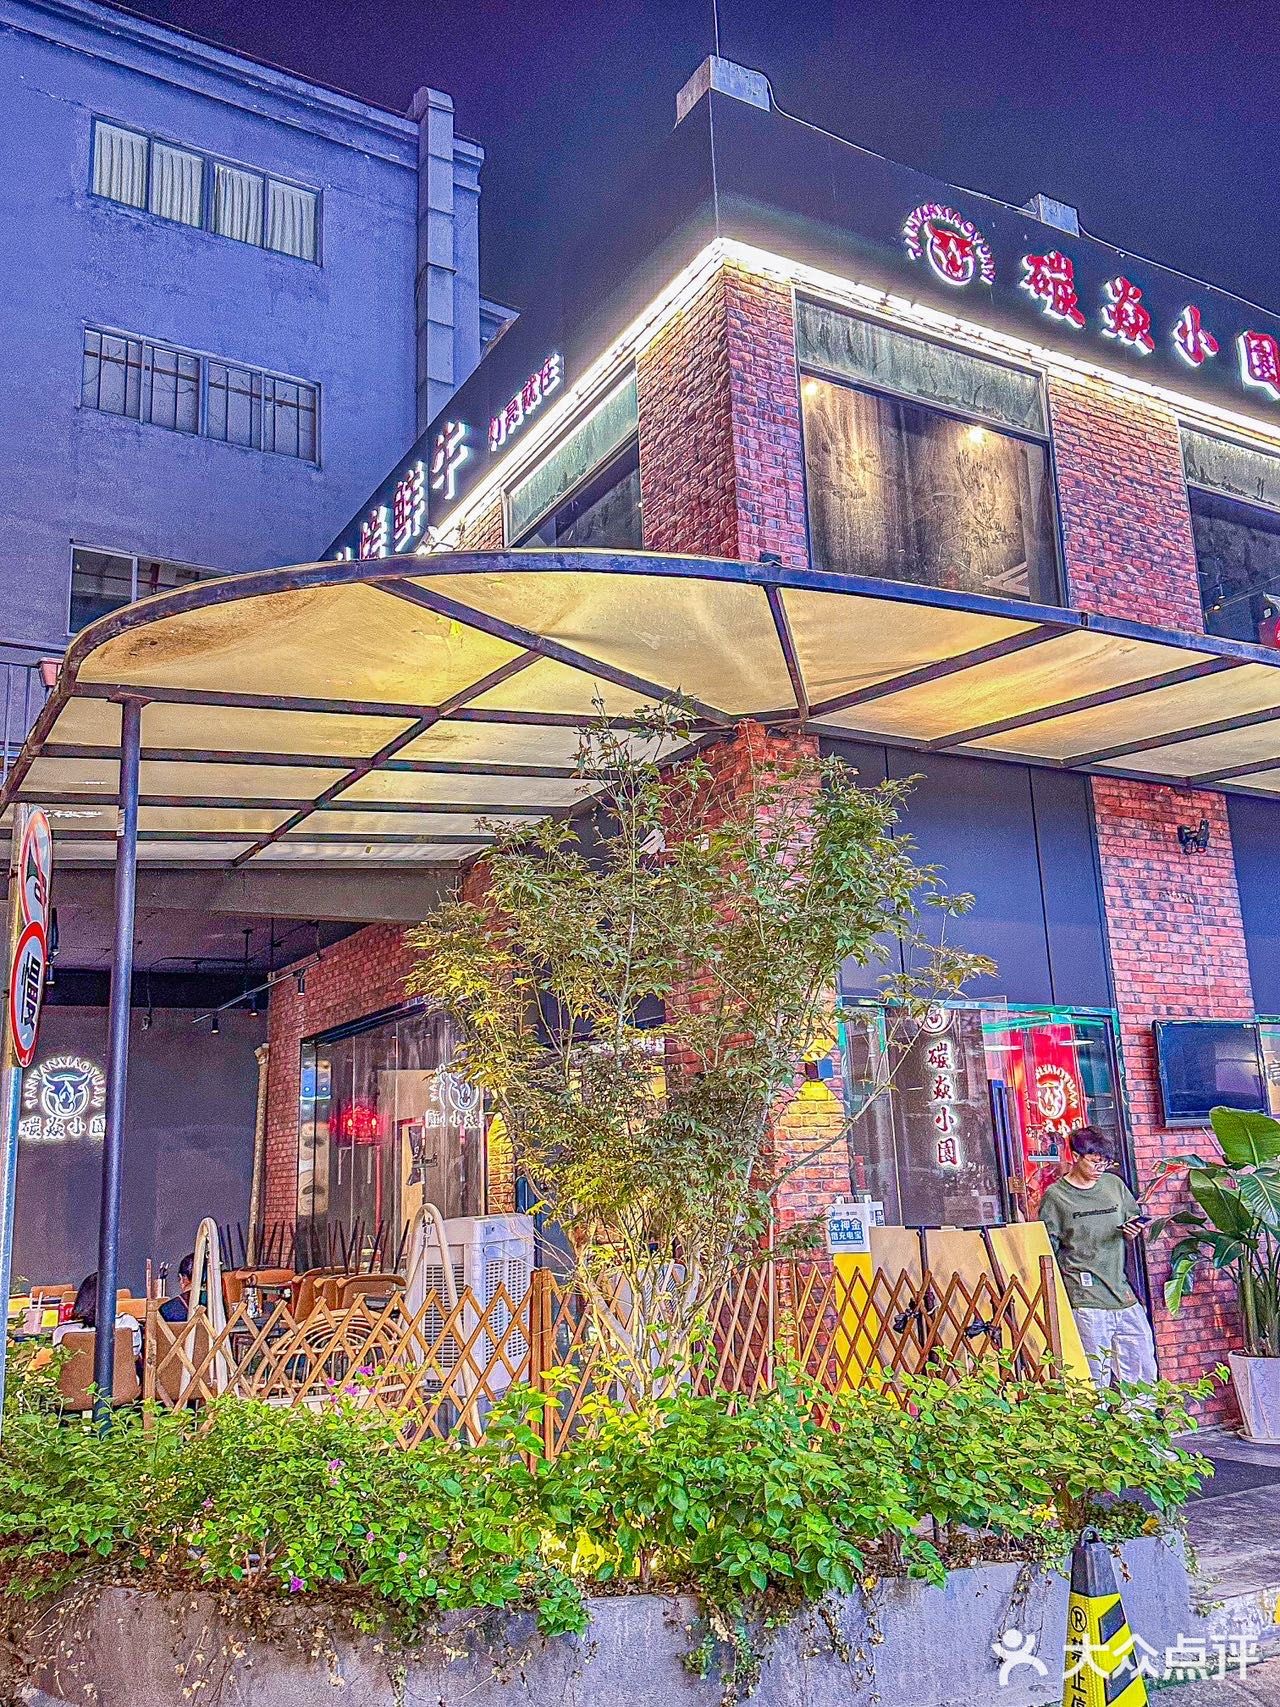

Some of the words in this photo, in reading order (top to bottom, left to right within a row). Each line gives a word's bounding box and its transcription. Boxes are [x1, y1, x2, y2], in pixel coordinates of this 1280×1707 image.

[25, 1056, 106, 1109] TANYANXIAOYUAN
[830, 1218, 862, 1232] 免押金
[831, 1231, 863, 1241] 借充电宝
